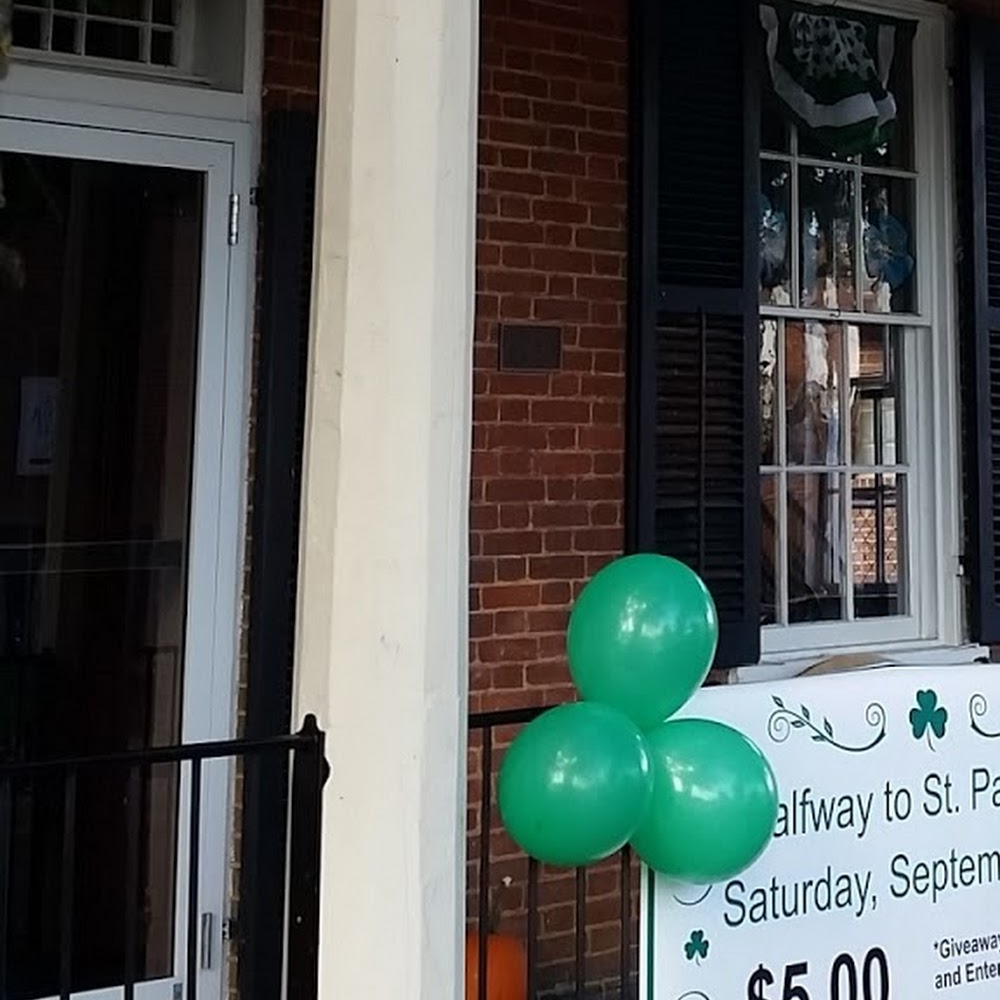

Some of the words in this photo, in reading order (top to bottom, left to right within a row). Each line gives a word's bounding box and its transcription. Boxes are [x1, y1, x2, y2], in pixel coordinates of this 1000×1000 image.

[773, 787, 874, 838] alfway
[884, 781, 912, 821] to
[923, 773, 959, 816] St.
[724, 865, 877, 927] Saturday,
[934, 965, 961, 989] and
